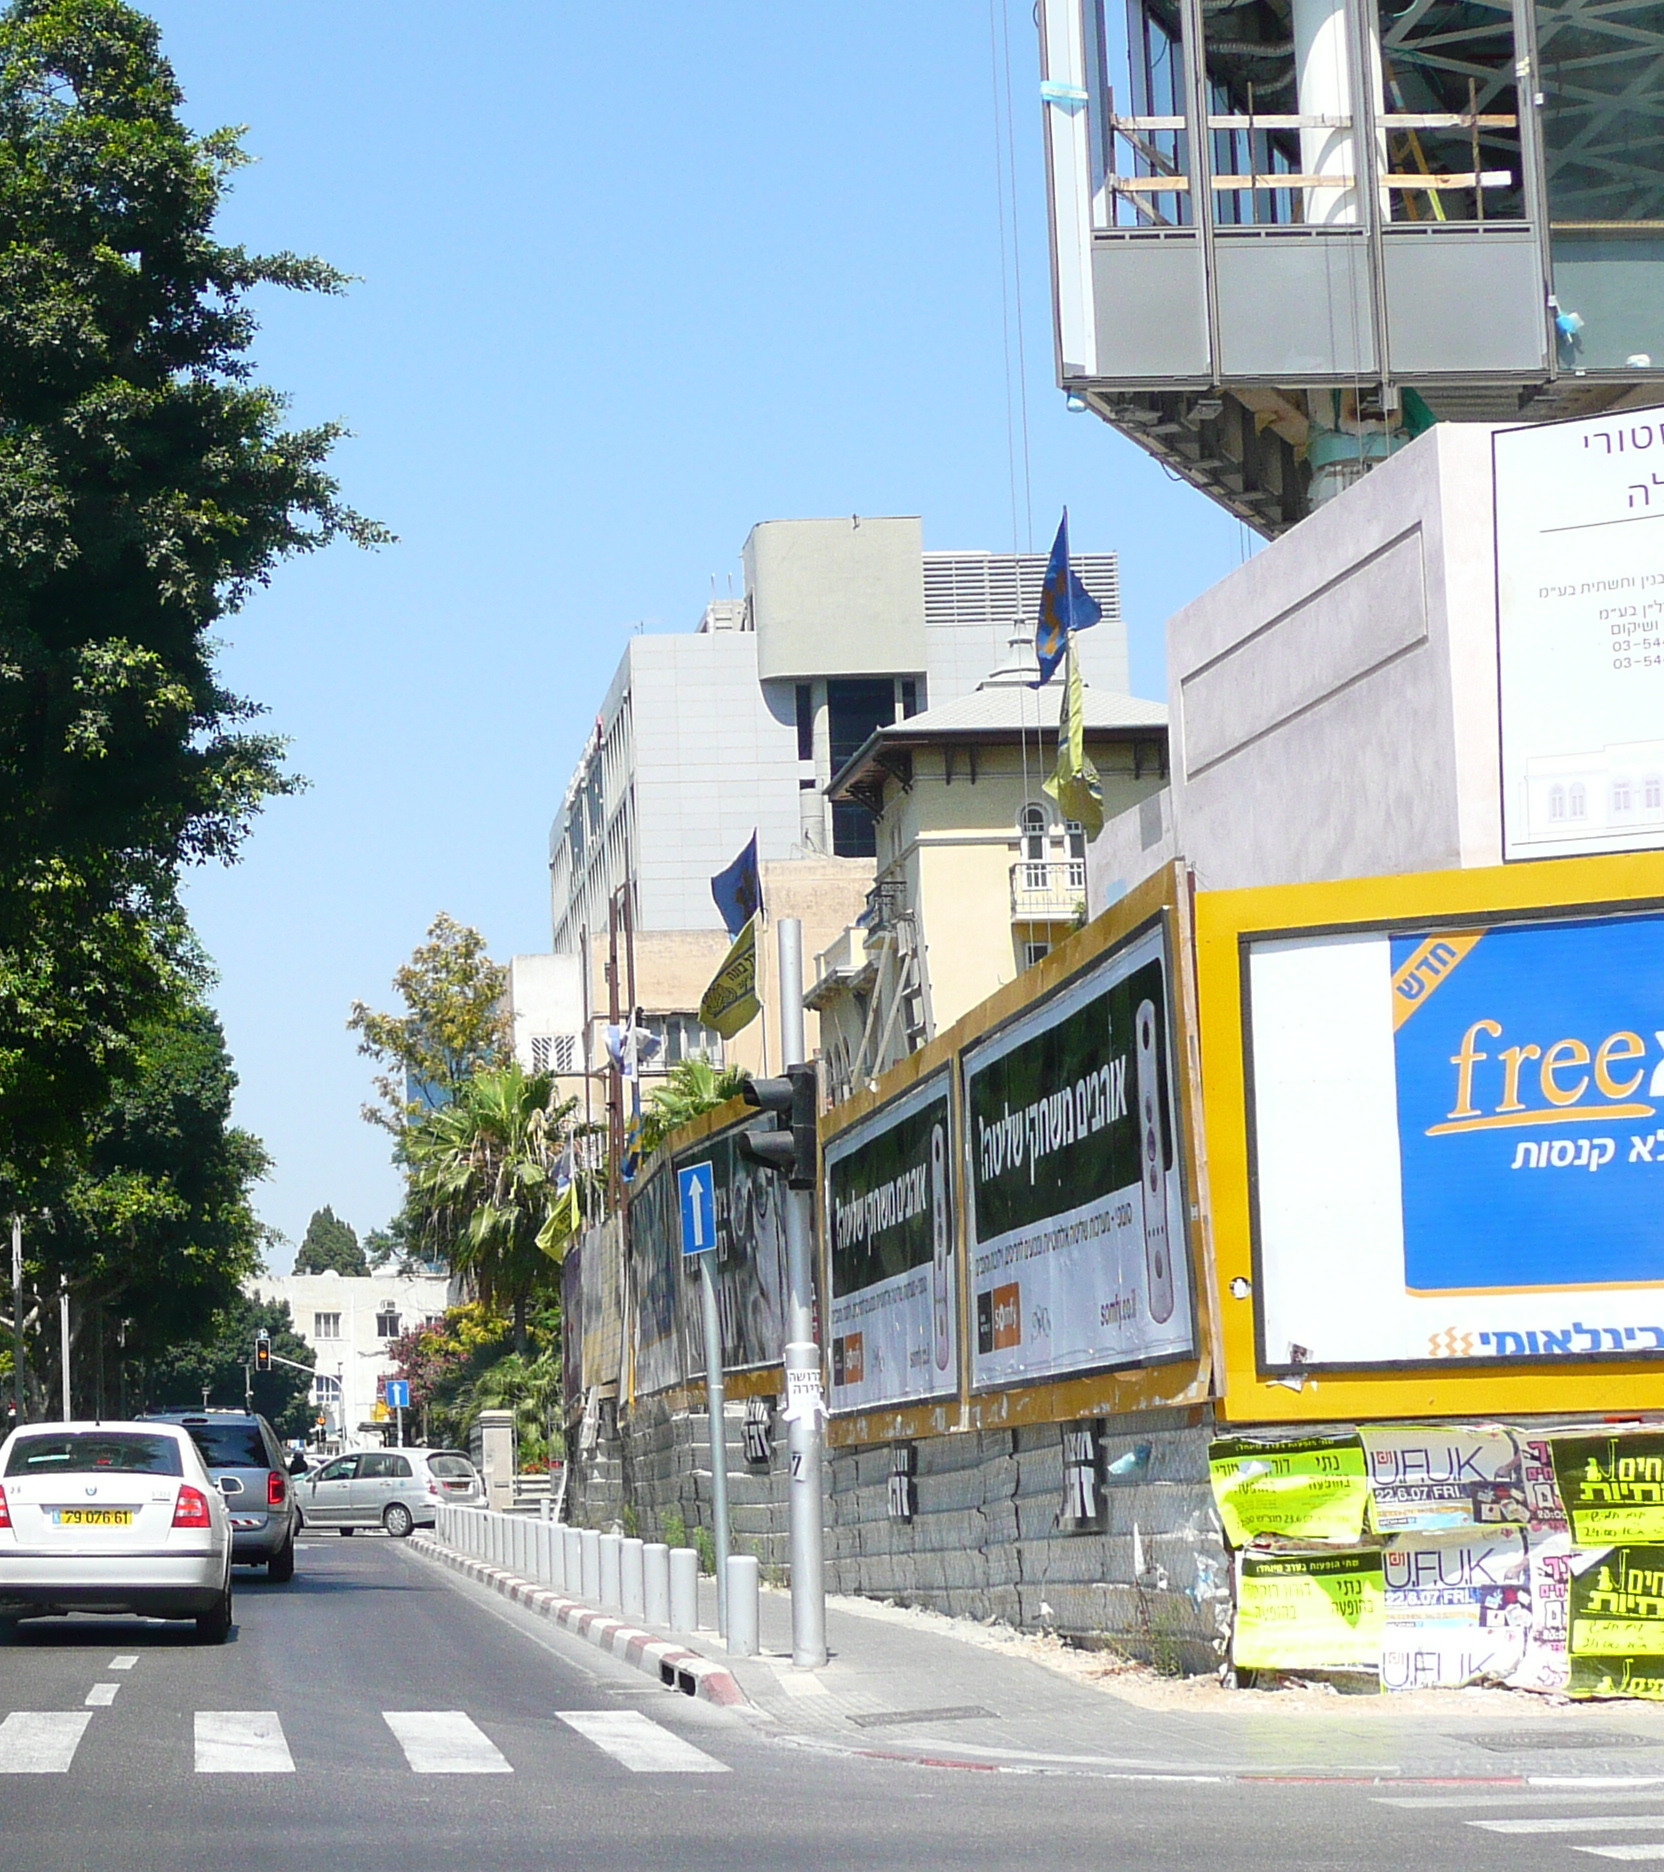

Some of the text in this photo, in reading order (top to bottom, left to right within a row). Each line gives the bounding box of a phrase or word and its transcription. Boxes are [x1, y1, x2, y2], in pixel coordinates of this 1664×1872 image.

[1584, 423, 1664, 454] טורי
[1612, 637, 1664, 652] 03-54
[1613, 655, 1664, 669] 03-54
[1396, 940, 1458, 1002] חדש
[1512, 1136, 1615, 1172] קנסות
[792, 1454, 802, 1477] 7
[64, 1510, 129, 1524] 79 076 61
[1337, 1579, 1362, 1596] נתי
